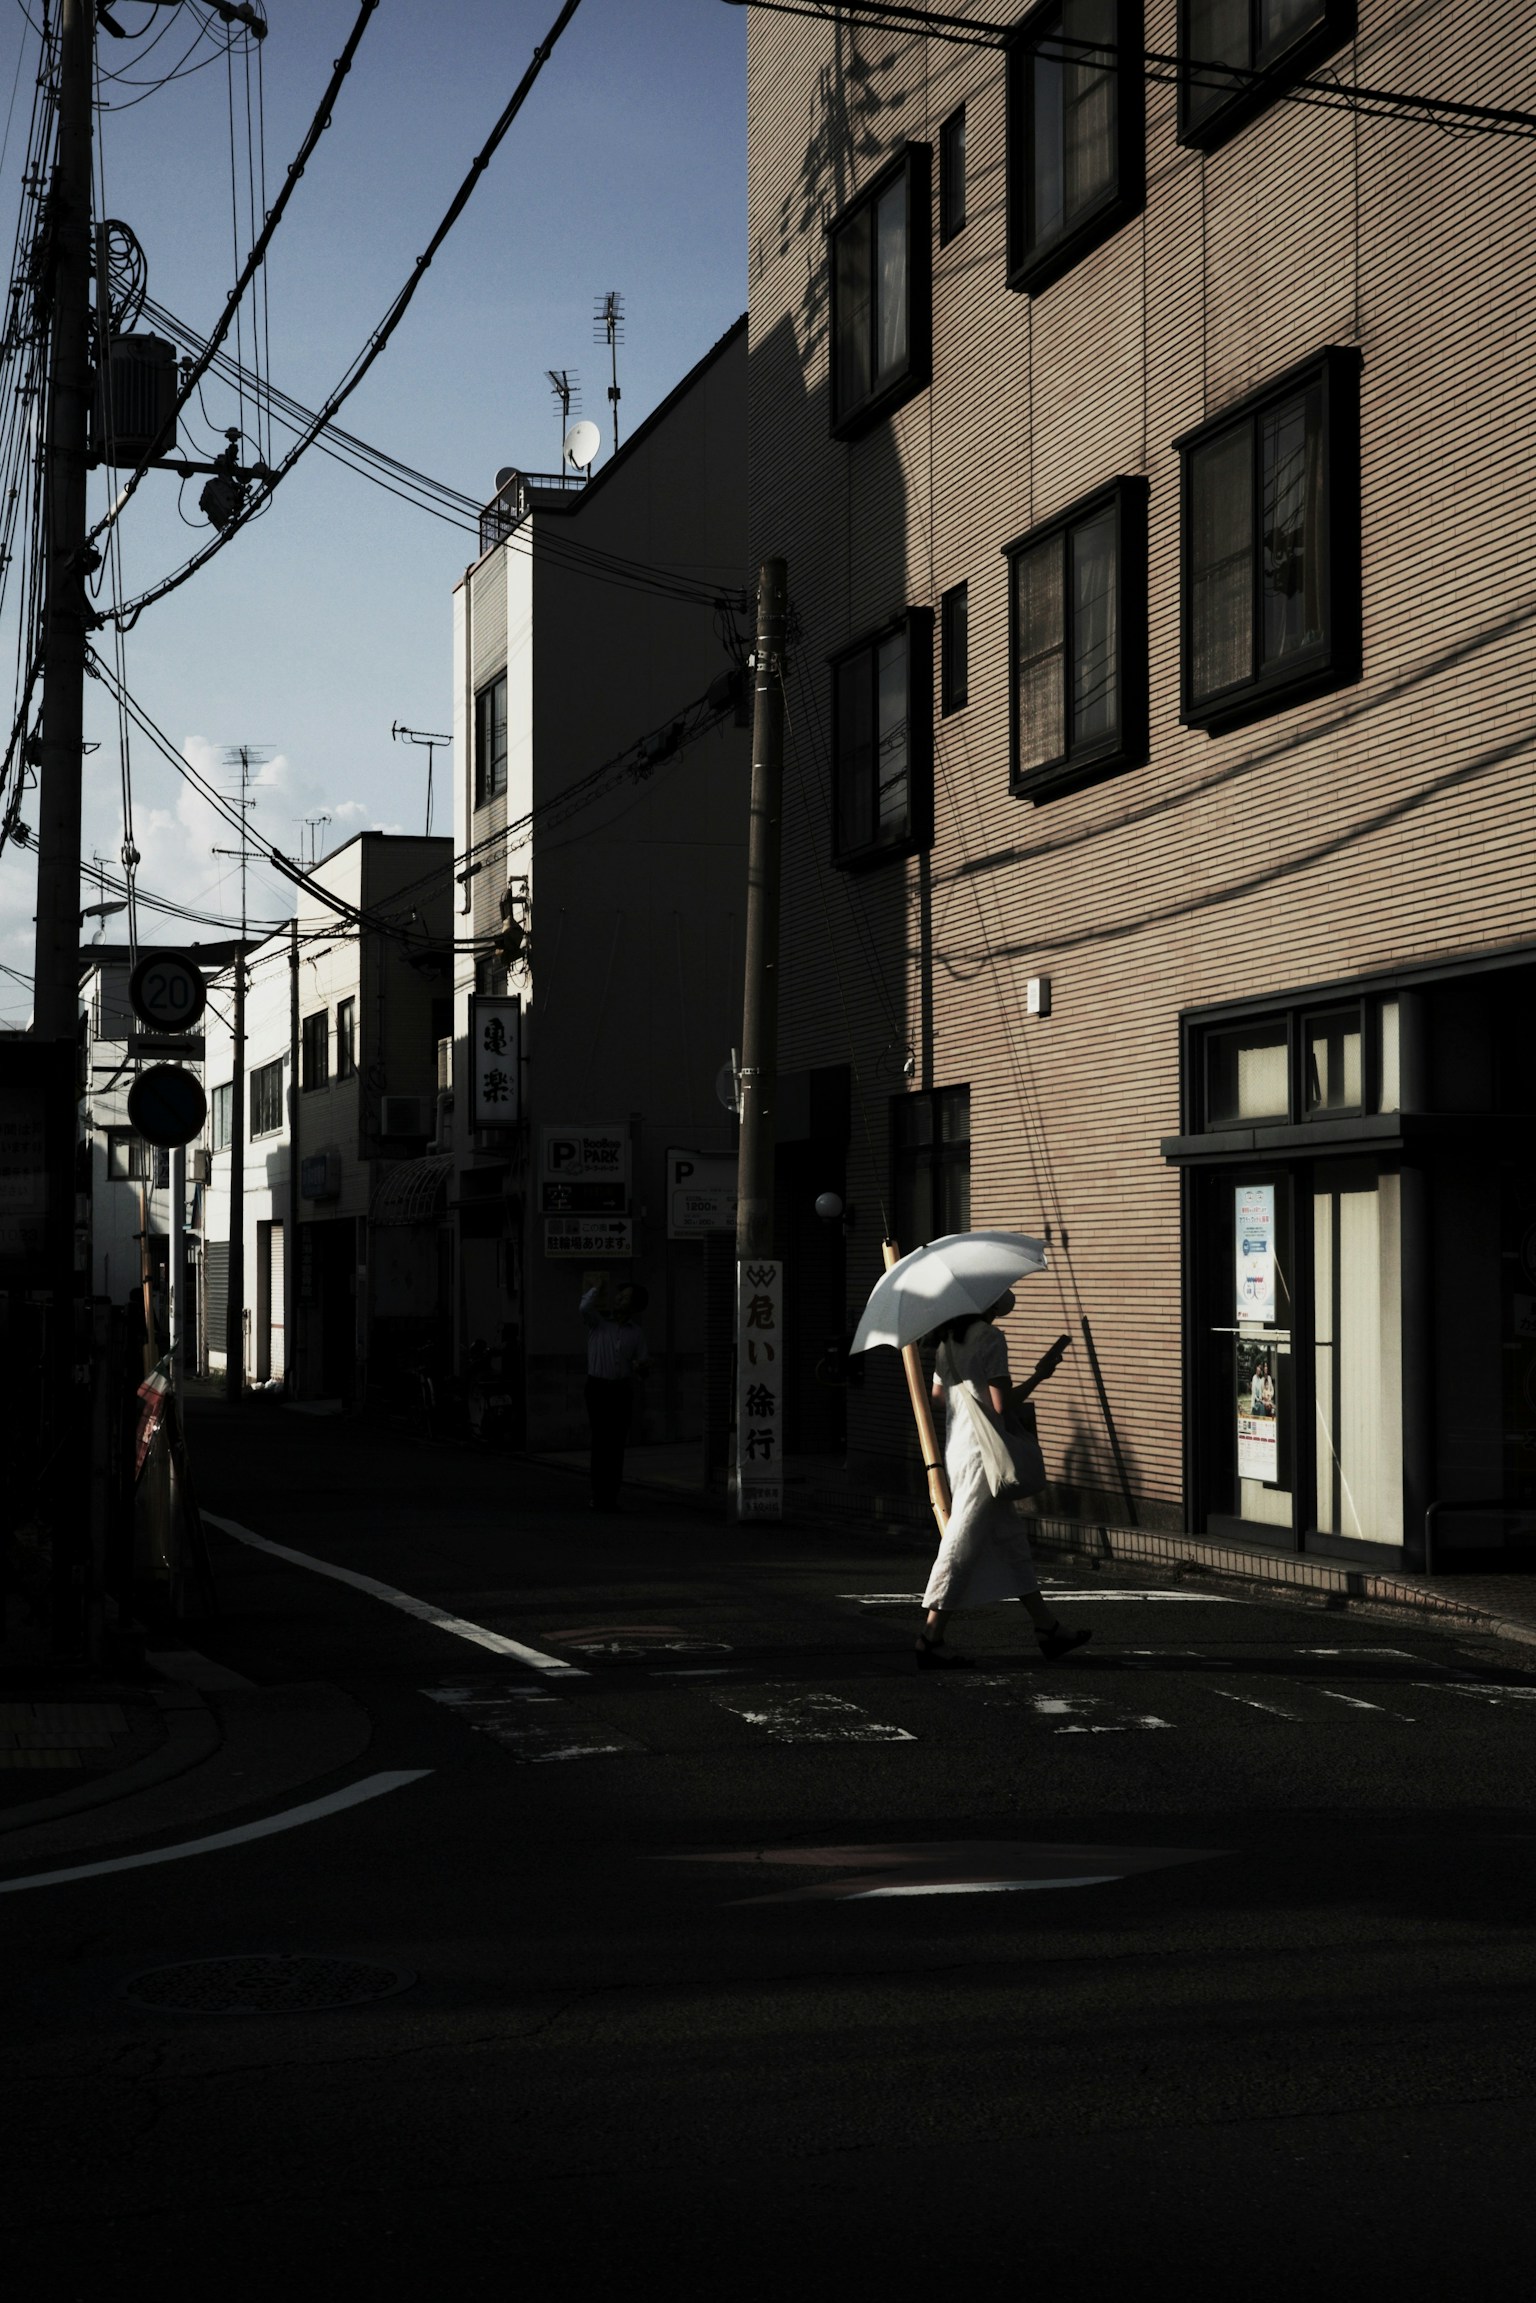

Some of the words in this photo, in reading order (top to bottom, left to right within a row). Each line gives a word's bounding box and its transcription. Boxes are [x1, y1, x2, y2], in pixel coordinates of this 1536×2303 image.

[148, 974, 188, 1009] 20
[553, 1142, 576, 1169] P
[584, 1149, 619, 1163] PARK
[676, 1161, 694, 1184] P
[547, 1236, 631, 1250] 駐輪場あります。
